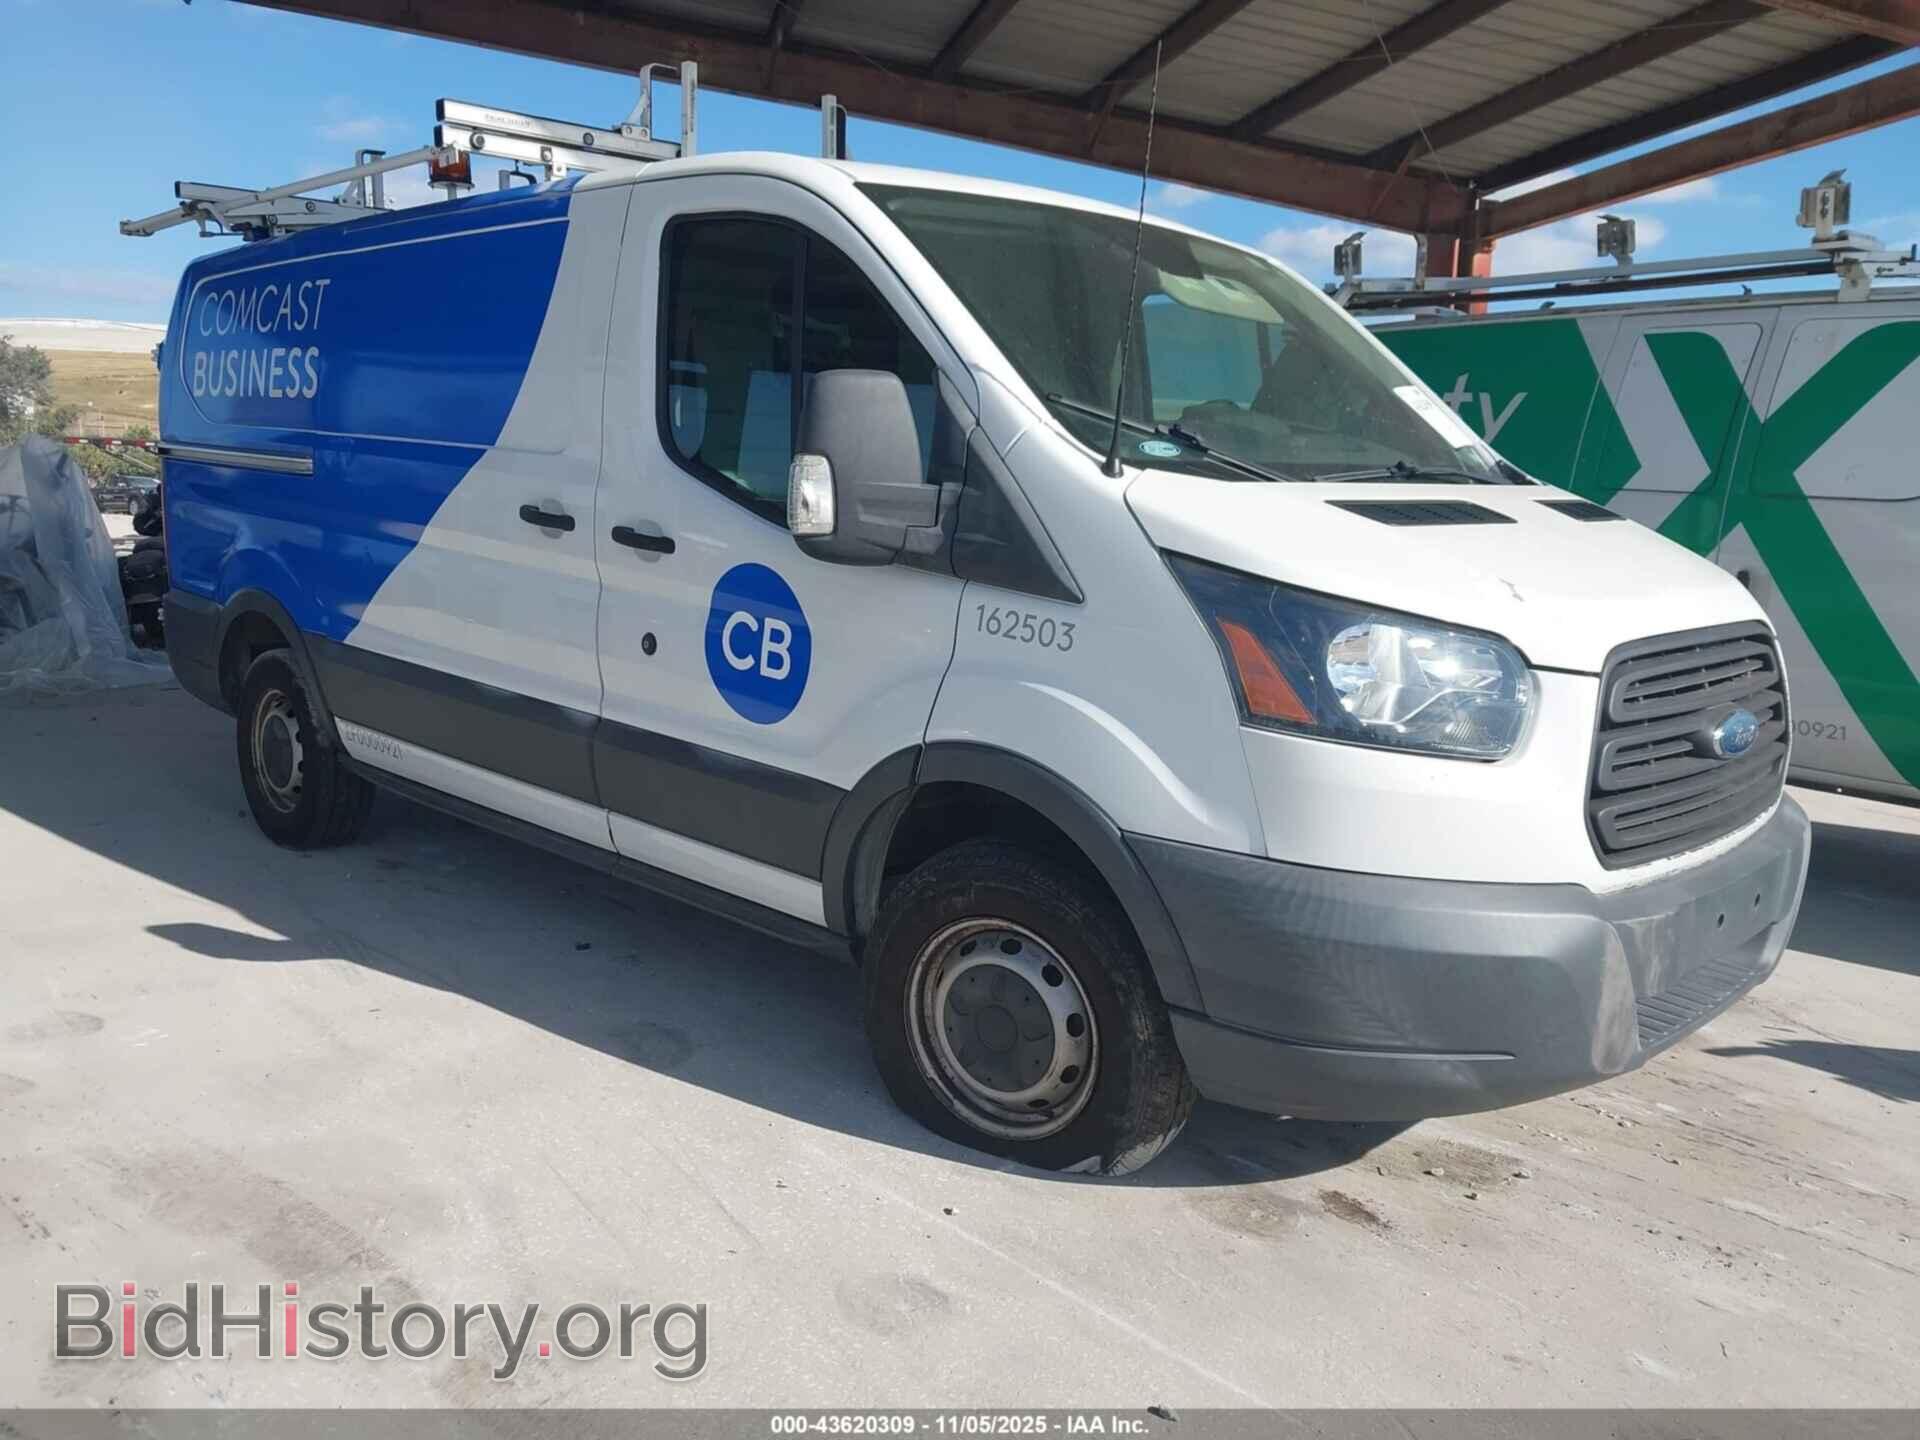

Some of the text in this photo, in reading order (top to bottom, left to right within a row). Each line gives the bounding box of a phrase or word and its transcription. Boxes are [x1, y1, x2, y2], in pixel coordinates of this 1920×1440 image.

[199, 279, 331, 337] COMCAST
[193, 346, 320, 399] BUSINESS
[722, 610, 792, 680] CB
[977, 604, 1077, 652] 162503
